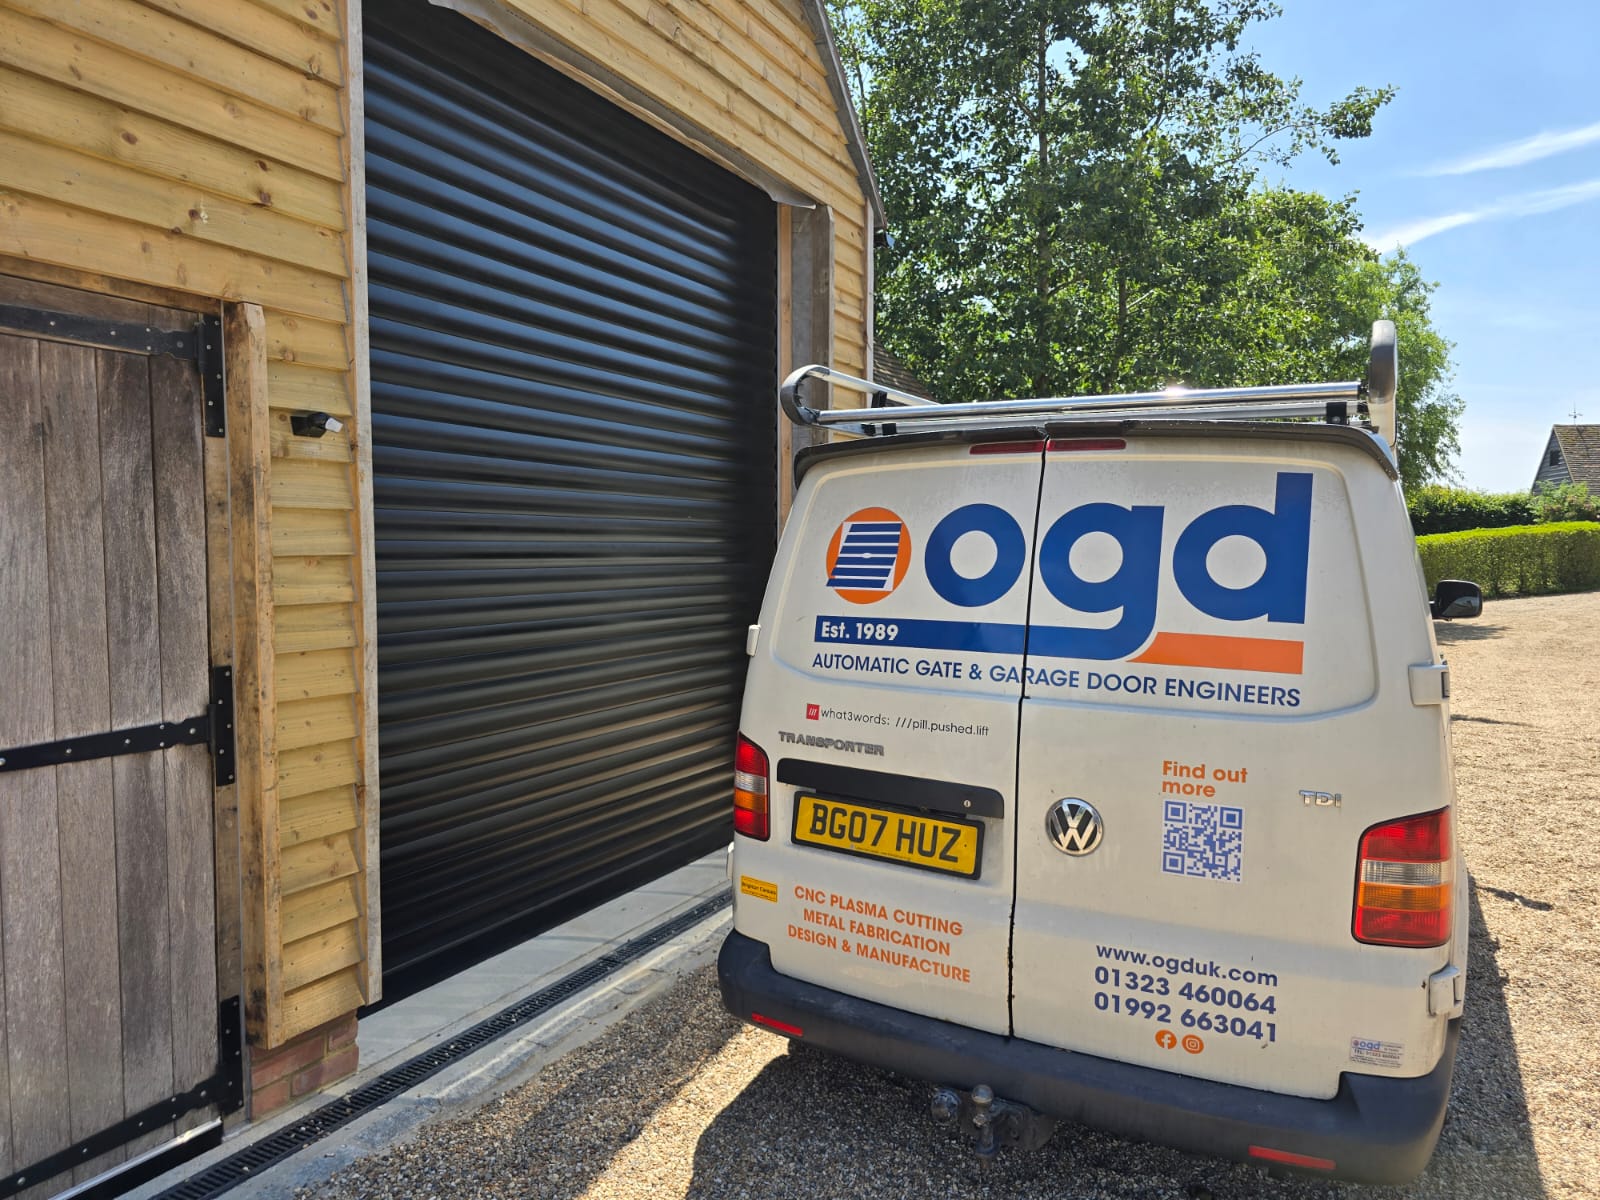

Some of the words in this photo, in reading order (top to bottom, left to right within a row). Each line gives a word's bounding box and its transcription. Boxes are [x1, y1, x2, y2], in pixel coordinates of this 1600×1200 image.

[924, 472, 1314, 661] ogd
[821, 621, 850, 639] Est.
[855, 622, 899, 641] 1989
[812, 653, 909, 675] AUTOMATIC
[915, 659, 963, 679] GATE
[968, 663, 982, 680] &
[989, 665, 1080, 688] GARAGE
[1087, 672, 1157, 695] DOOR
[1164, 678, 1301, 707] ENGINEERS
[821, 706, 890, 726] what3words:
[778, 731, 885, 756] TRANSPORTER
[1162, 760, 1206, 779] Find
[1213, 768, 1248, 783] out
[1162, 781, 1216, 797] more
[809, 803, 889, 848] BG07
[895, 818, 962, 863] HUZ
[794, 886, 826, 904] CNC
[830, 894, 888, 920] PLASMA
[893, 909, 963, 936] CUTTING
[803, 908, 846, 931] METAL
[850, 920, 950, 956] FABRICATION
[787, 924, 837, 949] DESIGN
[841, 939, 852, 953] &
[856, 942, 971, 983] MANUFACTURE
[1096, 945, 1278, 987] www.ogduk.com
[1094, 966, 1170, 996] 01323
[1178, 982, 1276, 1014] 460064
[1094, 992, 1171, 1023] 01992
[1180, 1009, 1276, 1042] 663041
